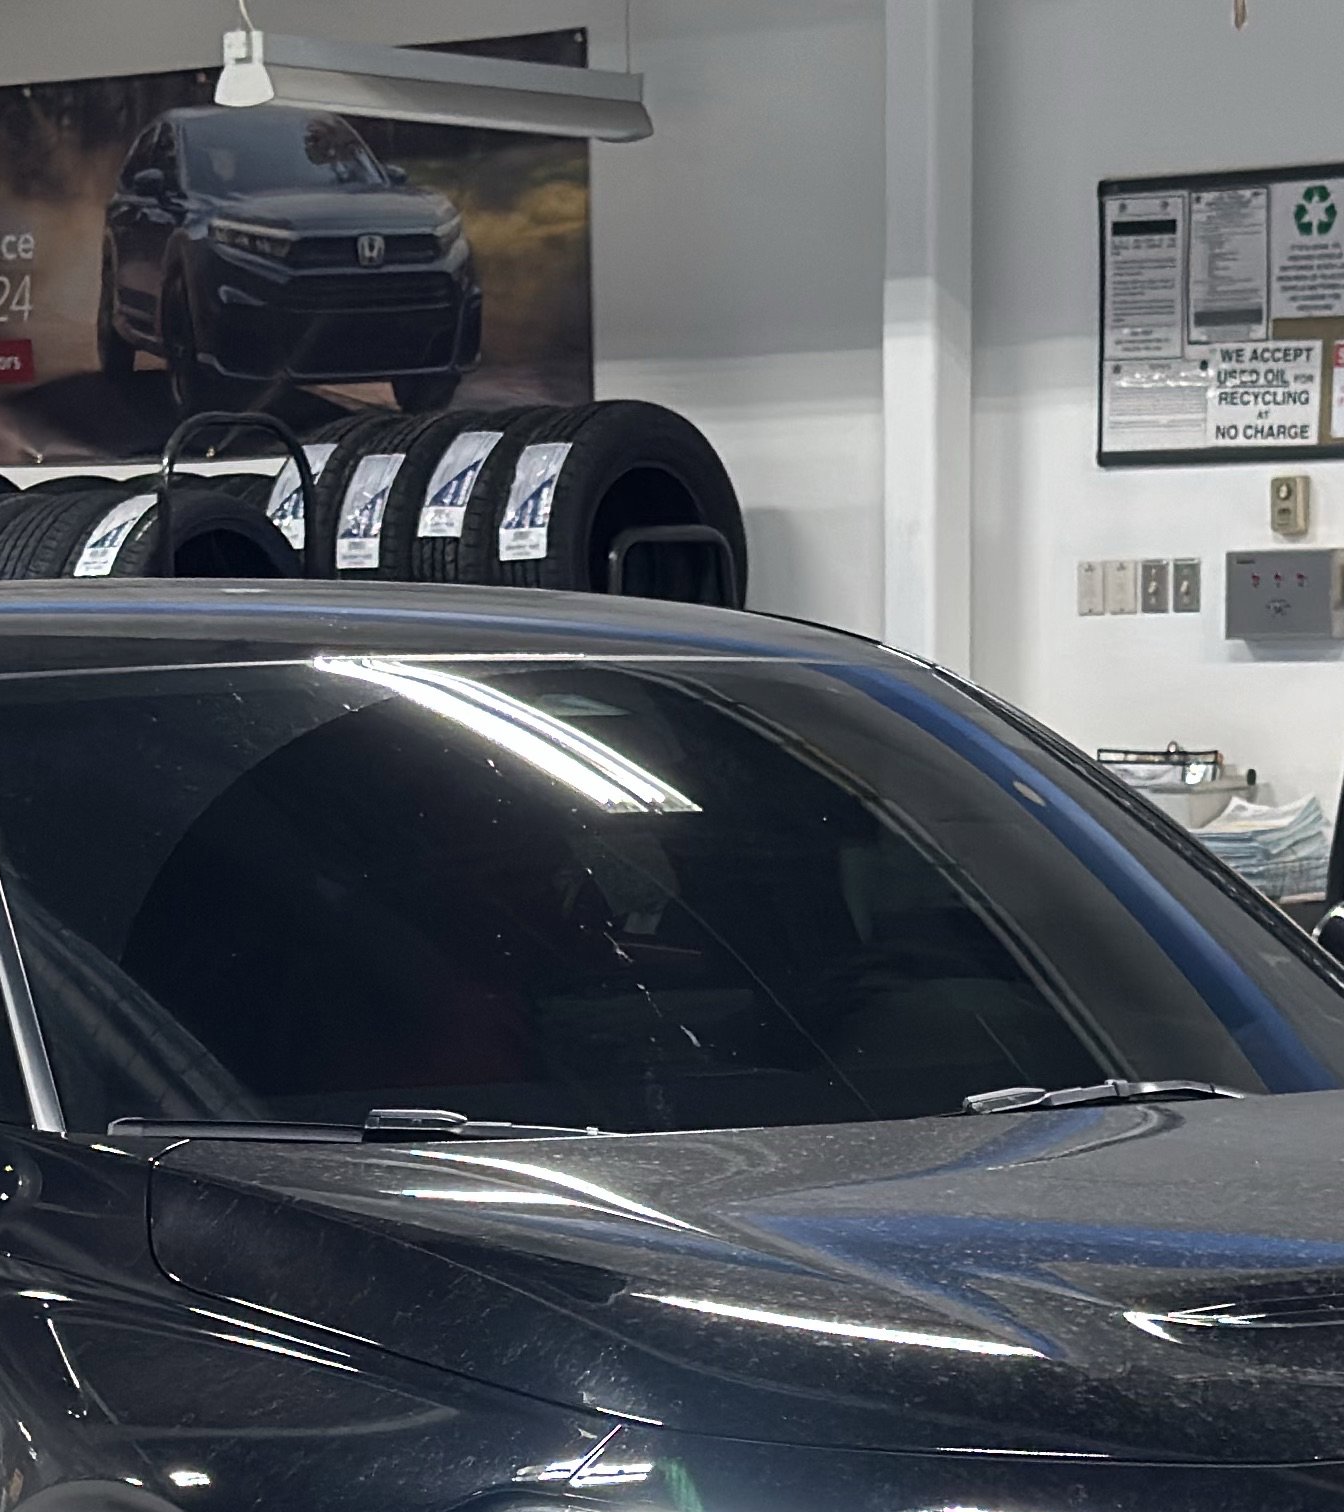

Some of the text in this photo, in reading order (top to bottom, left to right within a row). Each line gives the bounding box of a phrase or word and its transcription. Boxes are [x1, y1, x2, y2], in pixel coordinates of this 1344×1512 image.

[1220, 347, 1313, 363] WE ACCEPT
[1217, 369, 1260, 385] USED
[1264, 368, 1289, 384] OIL
[1218, 391, 1309, 405] RECYCLING
[1215, 424, 1310, 440] NO CHARGE
